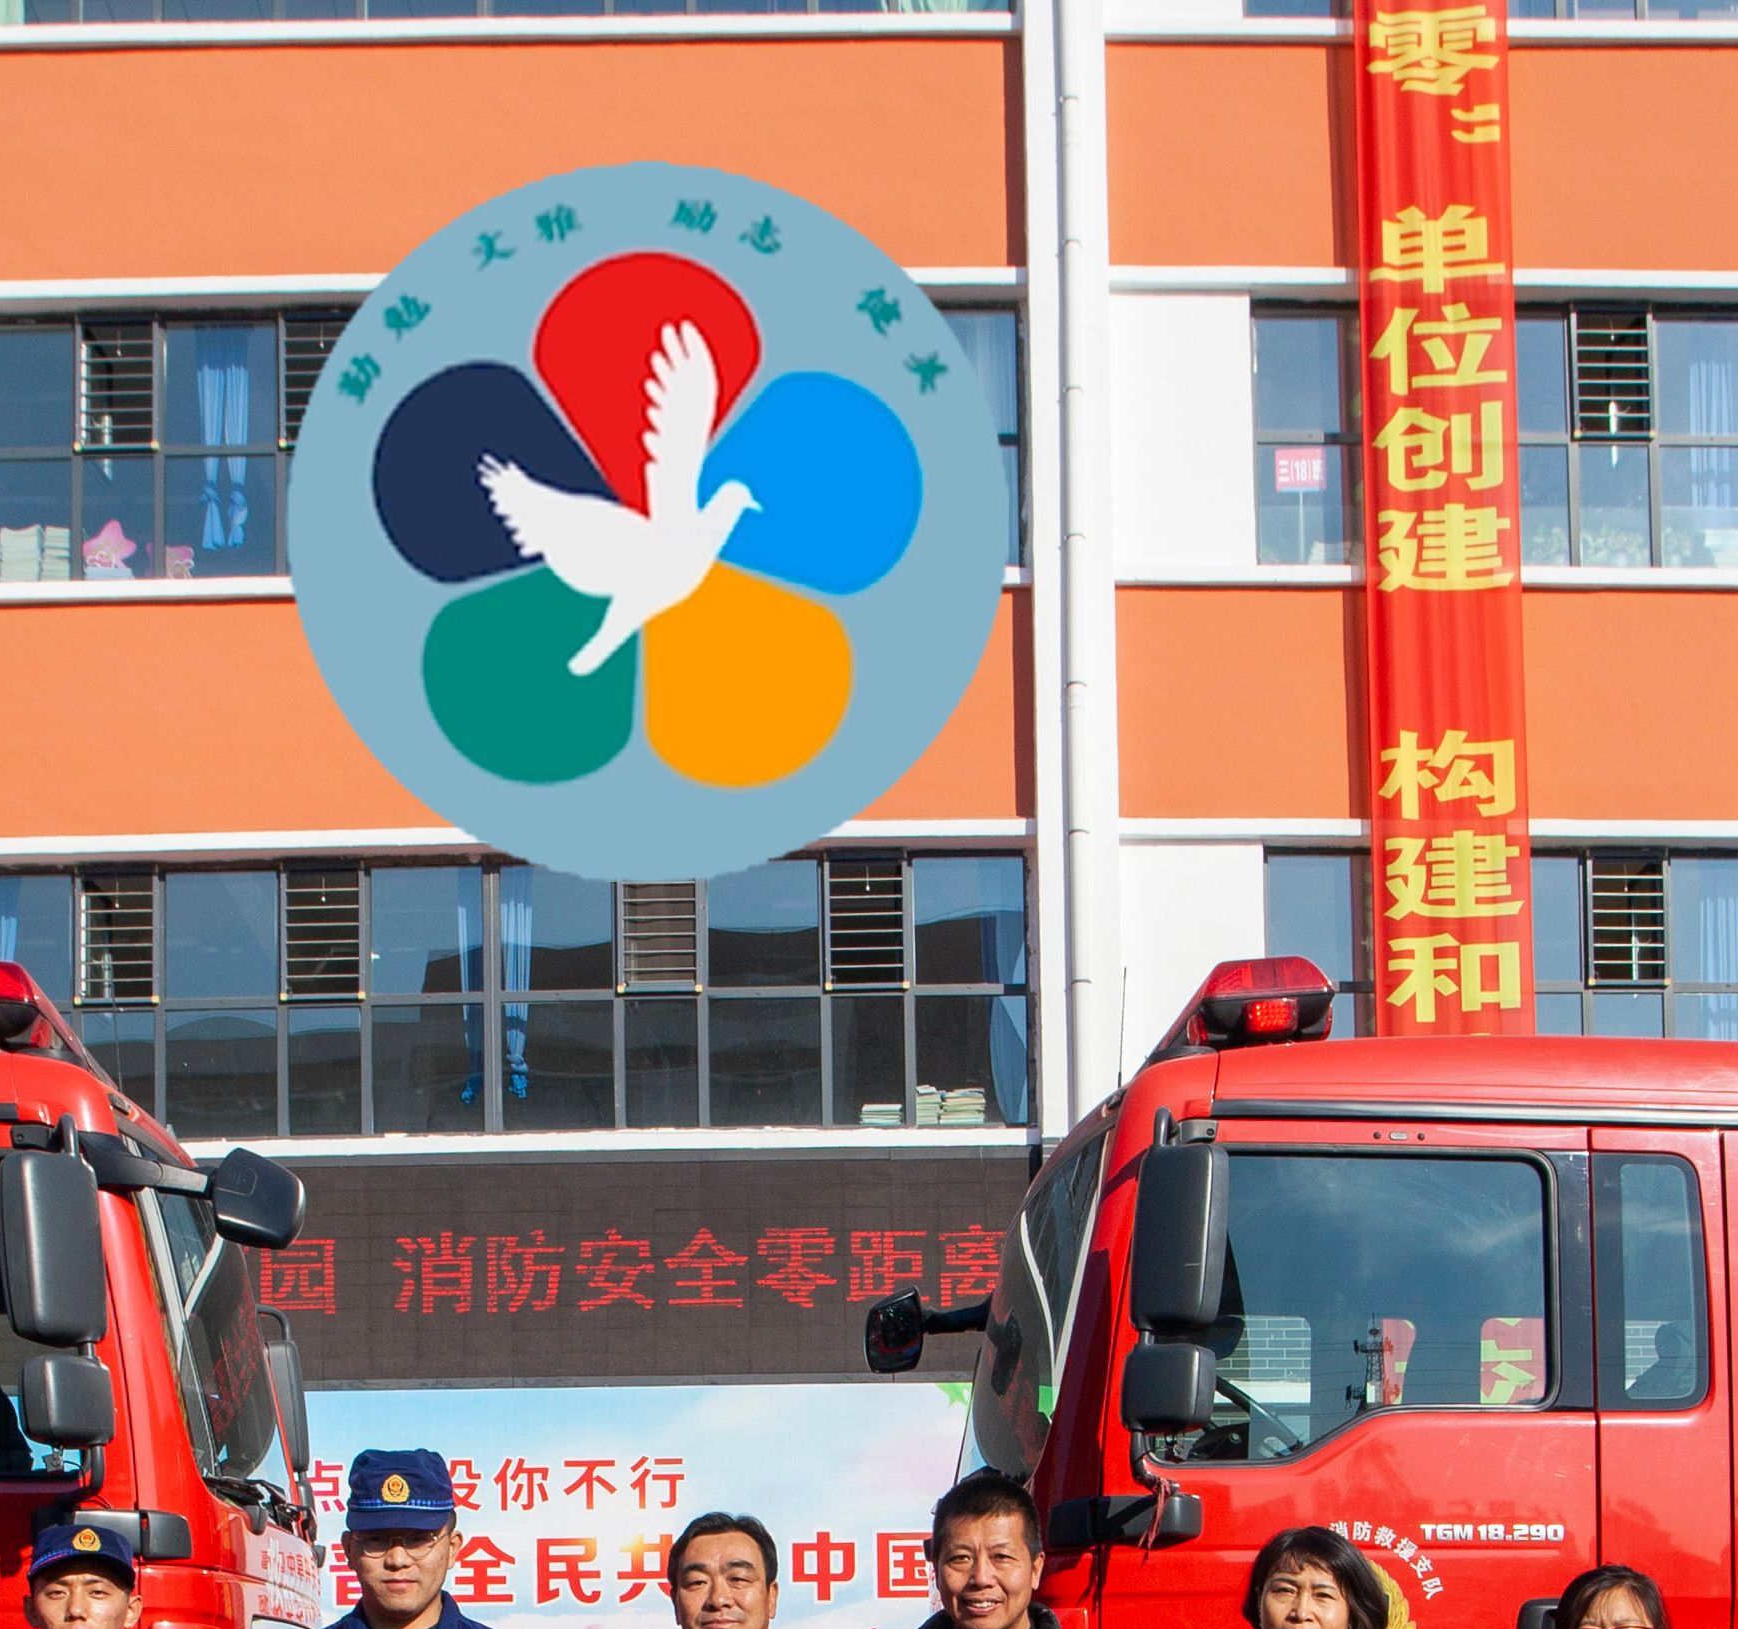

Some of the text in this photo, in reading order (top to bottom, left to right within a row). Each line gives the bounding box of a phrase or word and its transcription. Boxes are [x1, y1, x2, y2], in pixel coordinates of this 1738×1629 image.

[1369, 204, 1515, 593] 单位创建
[1378, 728, 1526, 1036] 构建和
[390, 1224, 1009, 1314] 消防安全零距离
[1419, 1523, 1566, 1542] TGM 18.290
